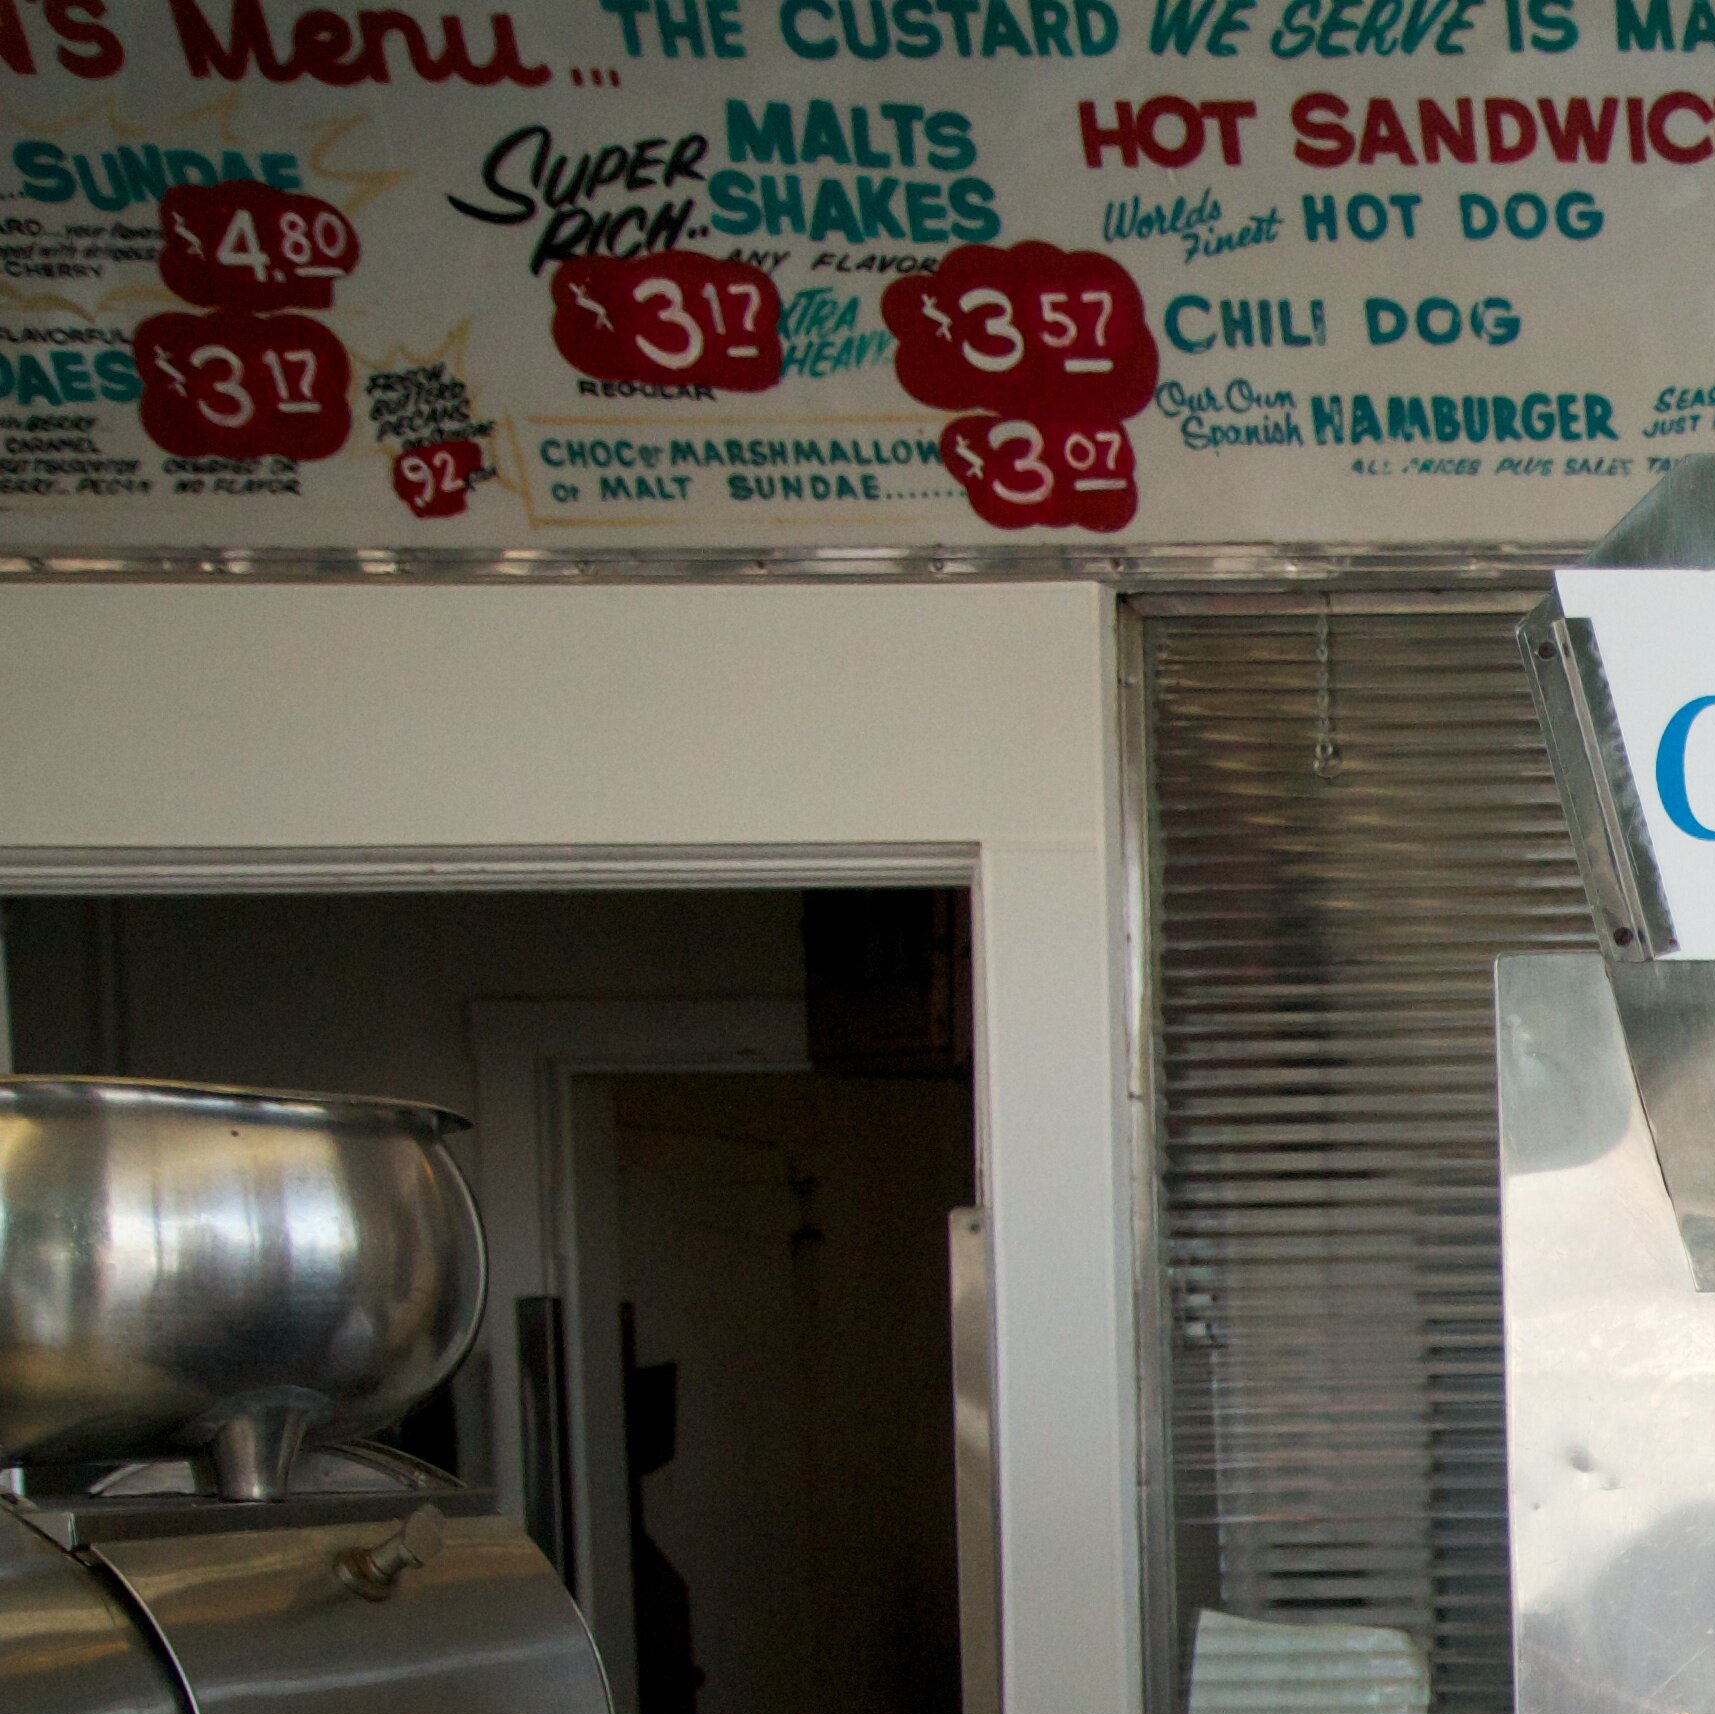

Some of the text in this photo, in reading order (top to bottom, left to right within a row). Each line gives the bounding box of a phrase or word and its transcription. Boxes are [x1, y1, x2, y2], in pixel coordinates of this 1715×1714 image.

[600, 0, 747, 58] THE
[779, 0, 1118, 60] CUSTARD
[1148, 0, 1256, 57] WE
[1271, 0, 1474, 58] SERVE
[1505, 0, 1578, 53] IS
[725, 98, 978, 172] MALTS
[1077, 94, 1257, 168] HOT
[447, 125, 709, 226] SUPER
[708, 169, 1001, 244] SHAKES
[1302, 190, 1605, 242] HOT DOG
[1181, 206, 1285, 264] Finest
[810, 252, 939, 273] FLAVOR
[1164, 294, 1521, 354] CHILI DOG
[1155, 380, 1223, 417] Our
[1311, 393, 1619, 445] HAMBURGER
[1180, 411, 1303, 457] Spanish
[1642, 413, 1701, 439] JUST
[540, 438, 634, 468] CHOC
[669, 437, 943, 467] MARSHMALLOW
[1496, 456, 1554, 476] PLUS
[1562, 456, 1635, 476] SALES
[600, 475, 693, 501] MALT
